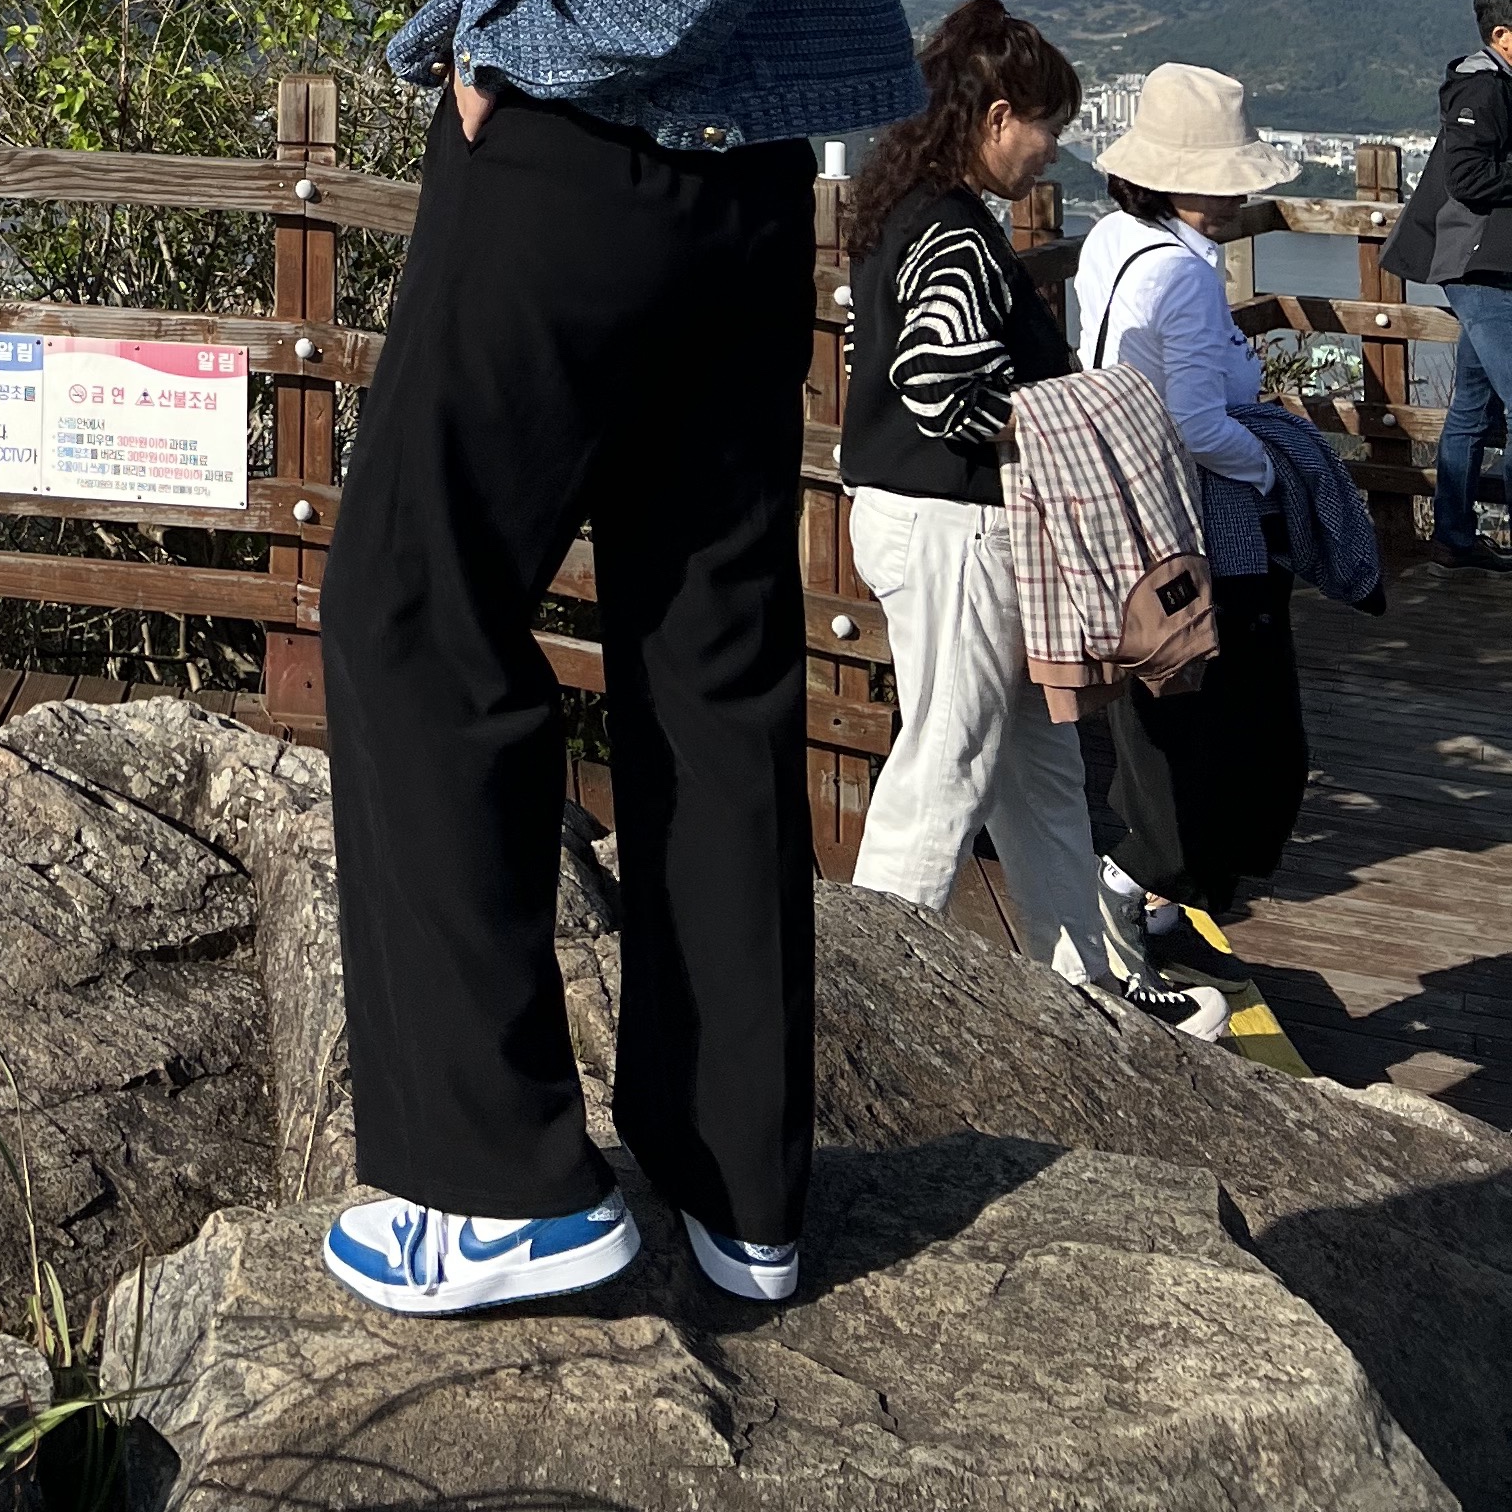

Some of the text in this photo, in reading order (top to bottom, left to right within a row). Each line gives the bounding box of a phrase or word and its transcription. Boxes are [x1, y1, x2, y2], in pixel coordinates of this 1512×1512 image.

[197, 351, 235, 373] 알림
[158, 389, 217, 410] 산불조심
[87, 434, 114, 446] 피우면
